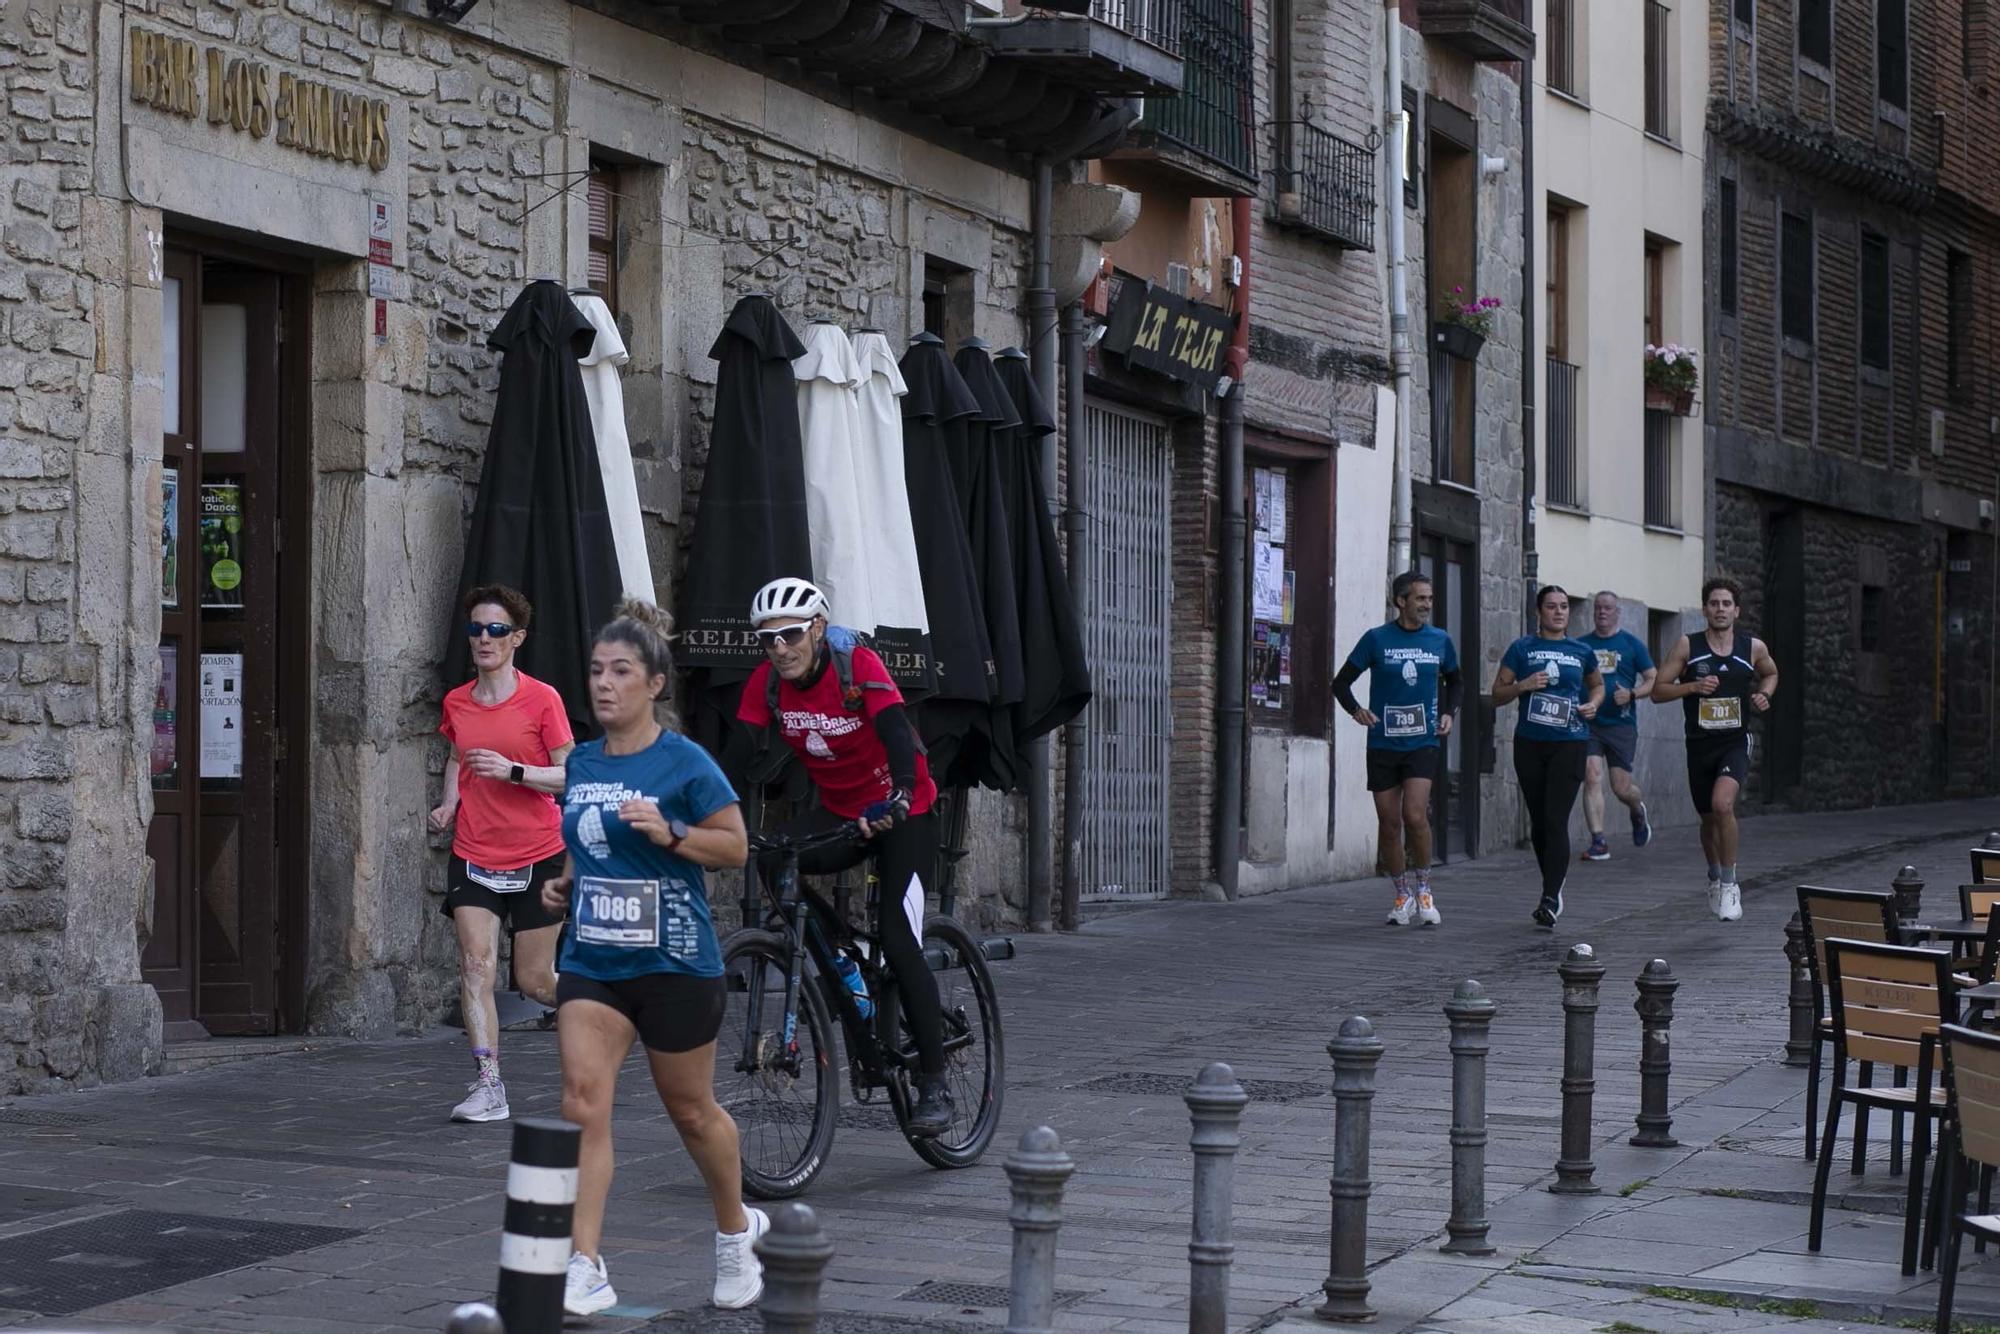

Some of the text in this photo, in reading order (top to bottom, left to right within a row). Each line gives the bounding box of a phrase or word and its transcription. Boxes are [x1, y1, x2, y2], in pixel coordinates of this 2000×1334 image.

[131, 26, 390, 171] BAR LOS AMIGOS
[1134, 302, 1224, 372] LA TEJA
[205, 503, 238, 512] Dance
[680, 629, 761, 646] KELE
[689, 647, 764, 656] DONOSTIA 187
[204, 688, 216, 697] DE
[1541, 701, 1560, 715] 740
[787, 716, 848, 730] ALMEDRA
[571, 789, 643, 804] ALMENDRA
[591, 895, 641, 922] 1086
[788, 1155, 820, 1187] MAXXIS
